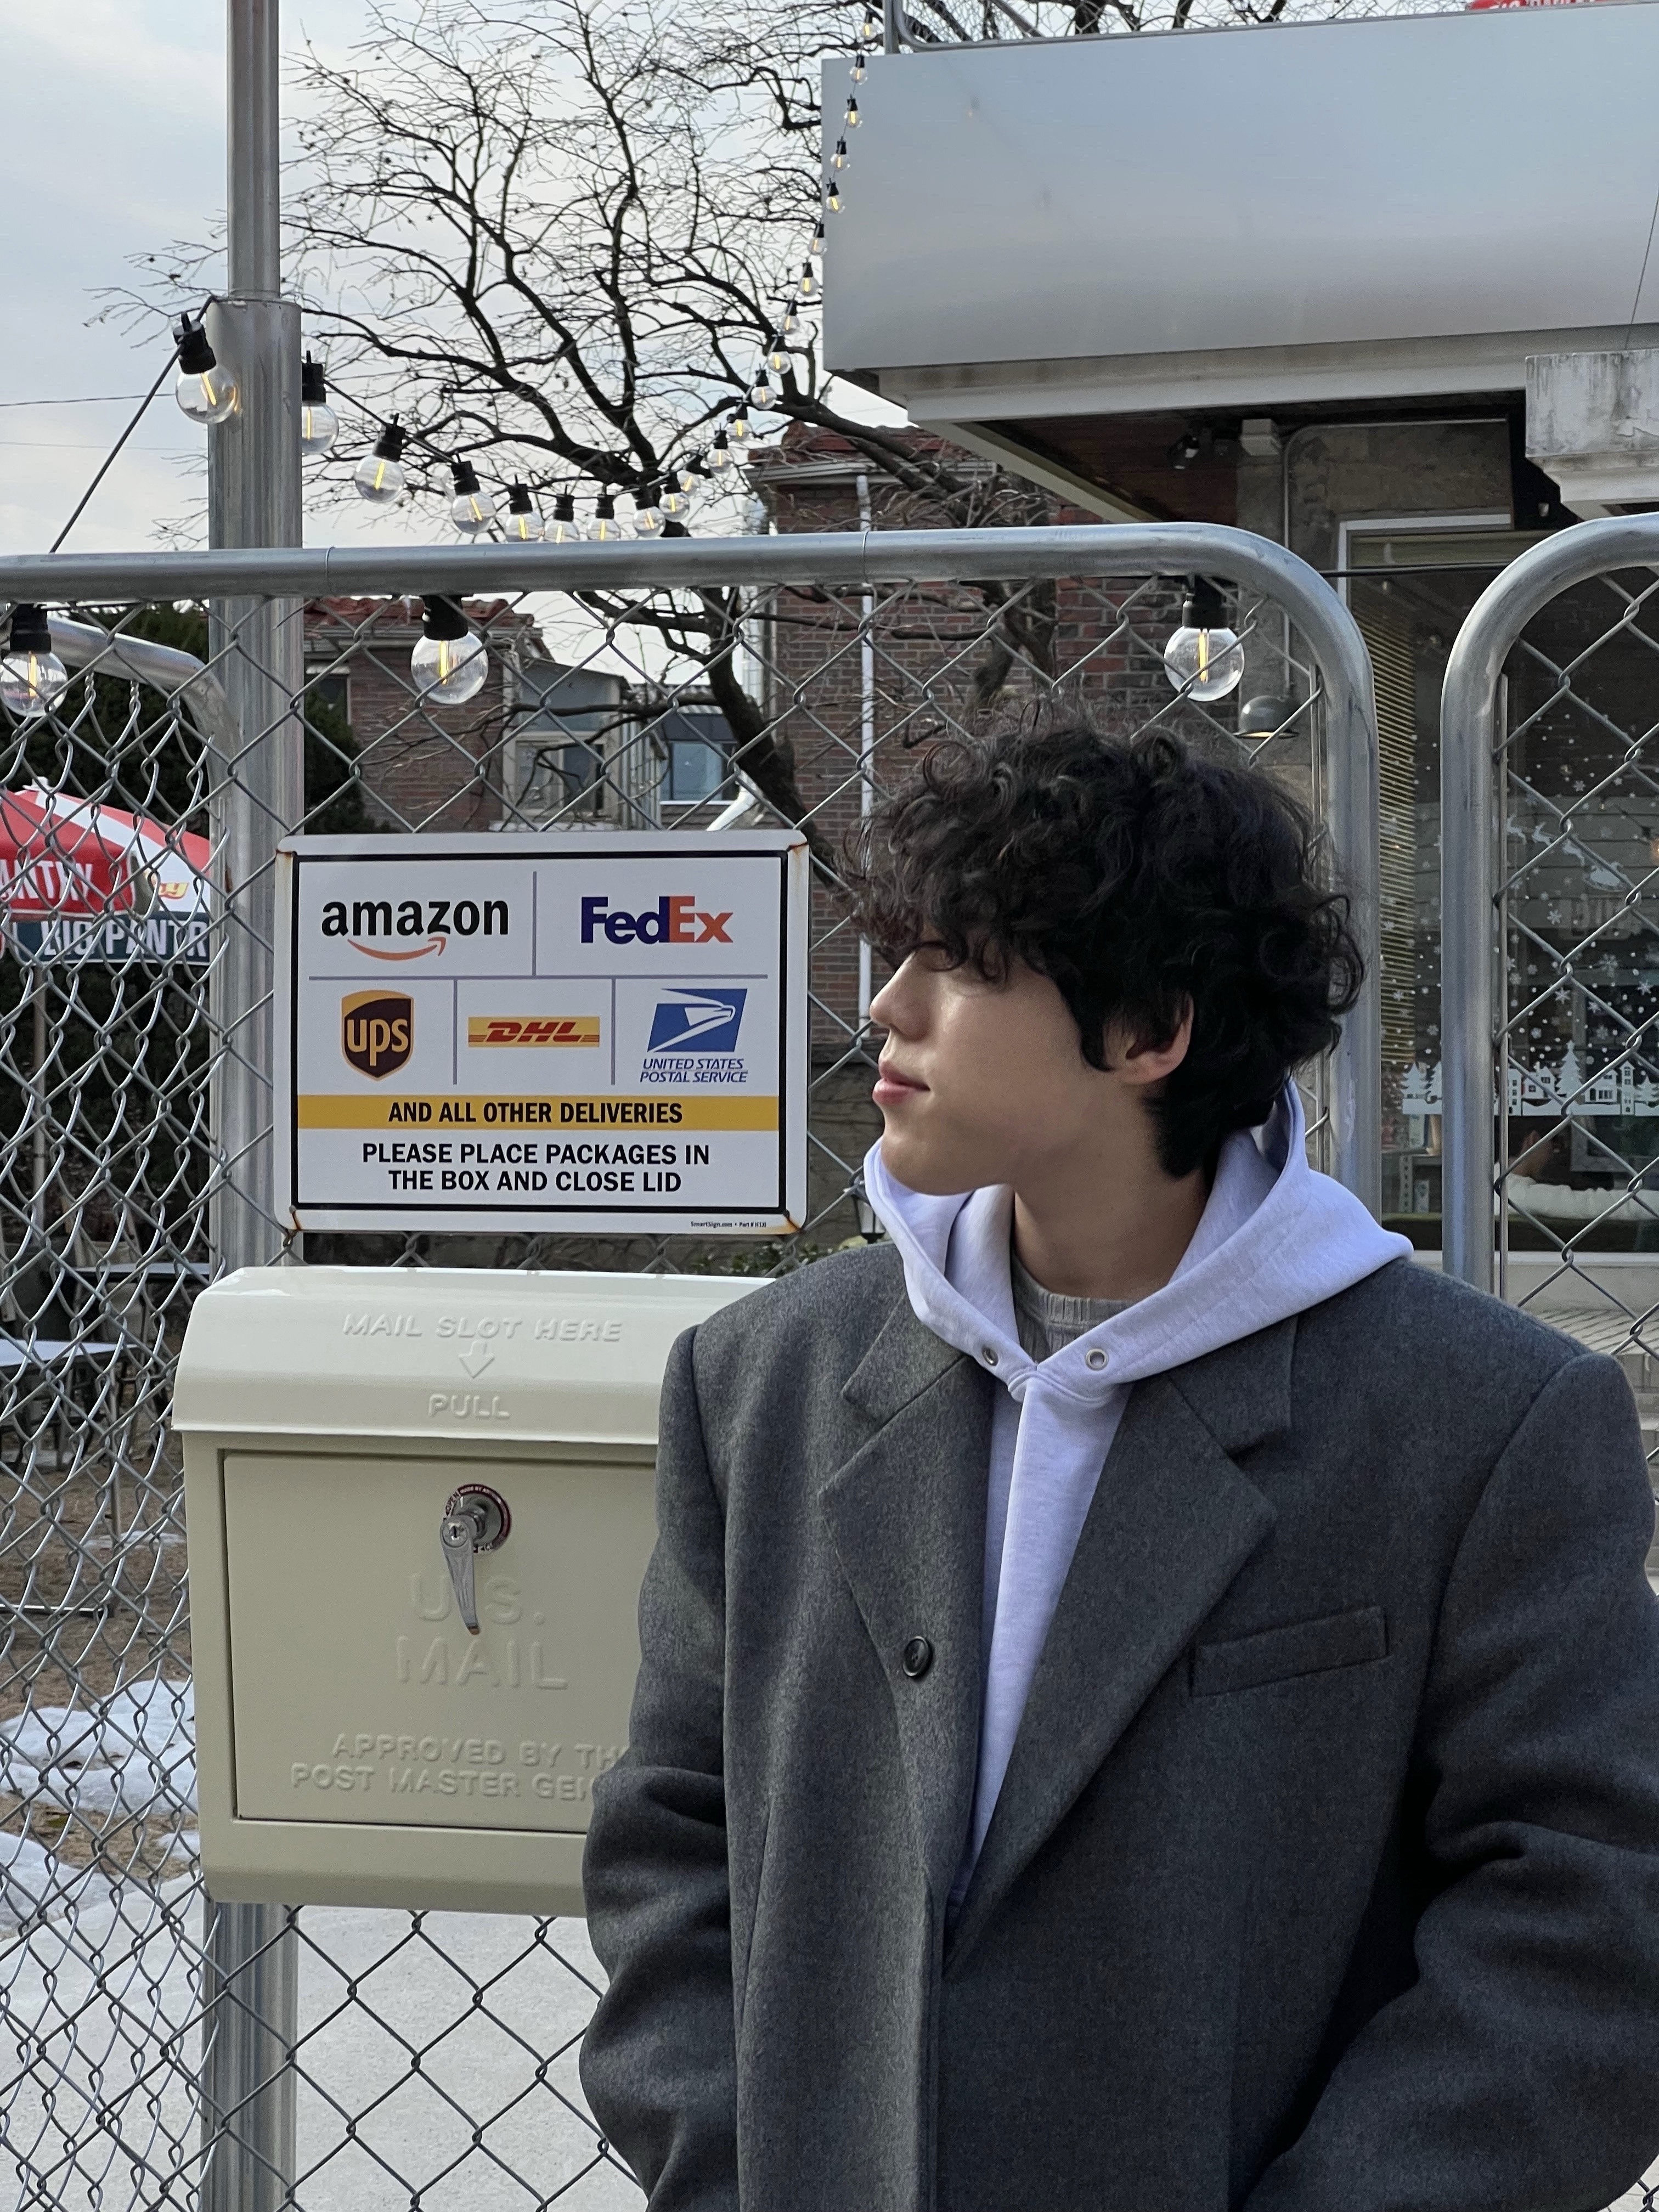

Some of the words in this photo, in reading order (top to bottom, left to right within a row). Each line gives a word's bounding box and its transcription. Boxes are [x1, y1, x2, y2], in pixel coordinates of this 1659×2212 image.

[321, 899, 509, 938] amazon
[581, 896, 733, 944] FedEx
[347, 1019, 408, 1067] ups
[482, 1022, 585, 1042] DHL
[640, 1071, 691, 1084] POSTAL
[692, 1071, 748, 1084] SERVICE
[644, 1058, 694, 1071] UNITED
[696, 1058, 744, 1071] STATES
[388, 1102, 432, 1123] AND
[439, 1103, 477, 1123] ALL
[483, 1103, 552, 1124] OTHER
[560, 1103, 683, 1124] DELIVERIES
[363, 1143, 453, 1164] PLEASE
[460, 1144, 538, 1164] PLACE
[546, 1144, 677, 1165] PACKAGES
[686, 1145, 709, 1165] IN
[388, 1170, 434, 1190] THE
[442, 1171, 490, 1191] BOX
[496, 1171, 548, 1192] AND
[555, 1171, 635, 1192] CLOSE
[643, 1172, 682, 1193] LID
[342, 1314, 422, 1337] MAIL
[435, 1317, 523, 1339] SLOT
[534, 1319, 623, 1342] HERE
[428, 1393, 510, 1420] PULL
[408, 1572, 545, 1626] US.
[396, 1635, 569, 1691] MAIL
[331, 1733, 506, 1765] APPROVED
[518, 1740, 562, 1768] BY
[573, 1743, 627, 1769] TH
[290, 1762, 376, 1792] POST
[388, 1766, 522, 1798] MASTER
